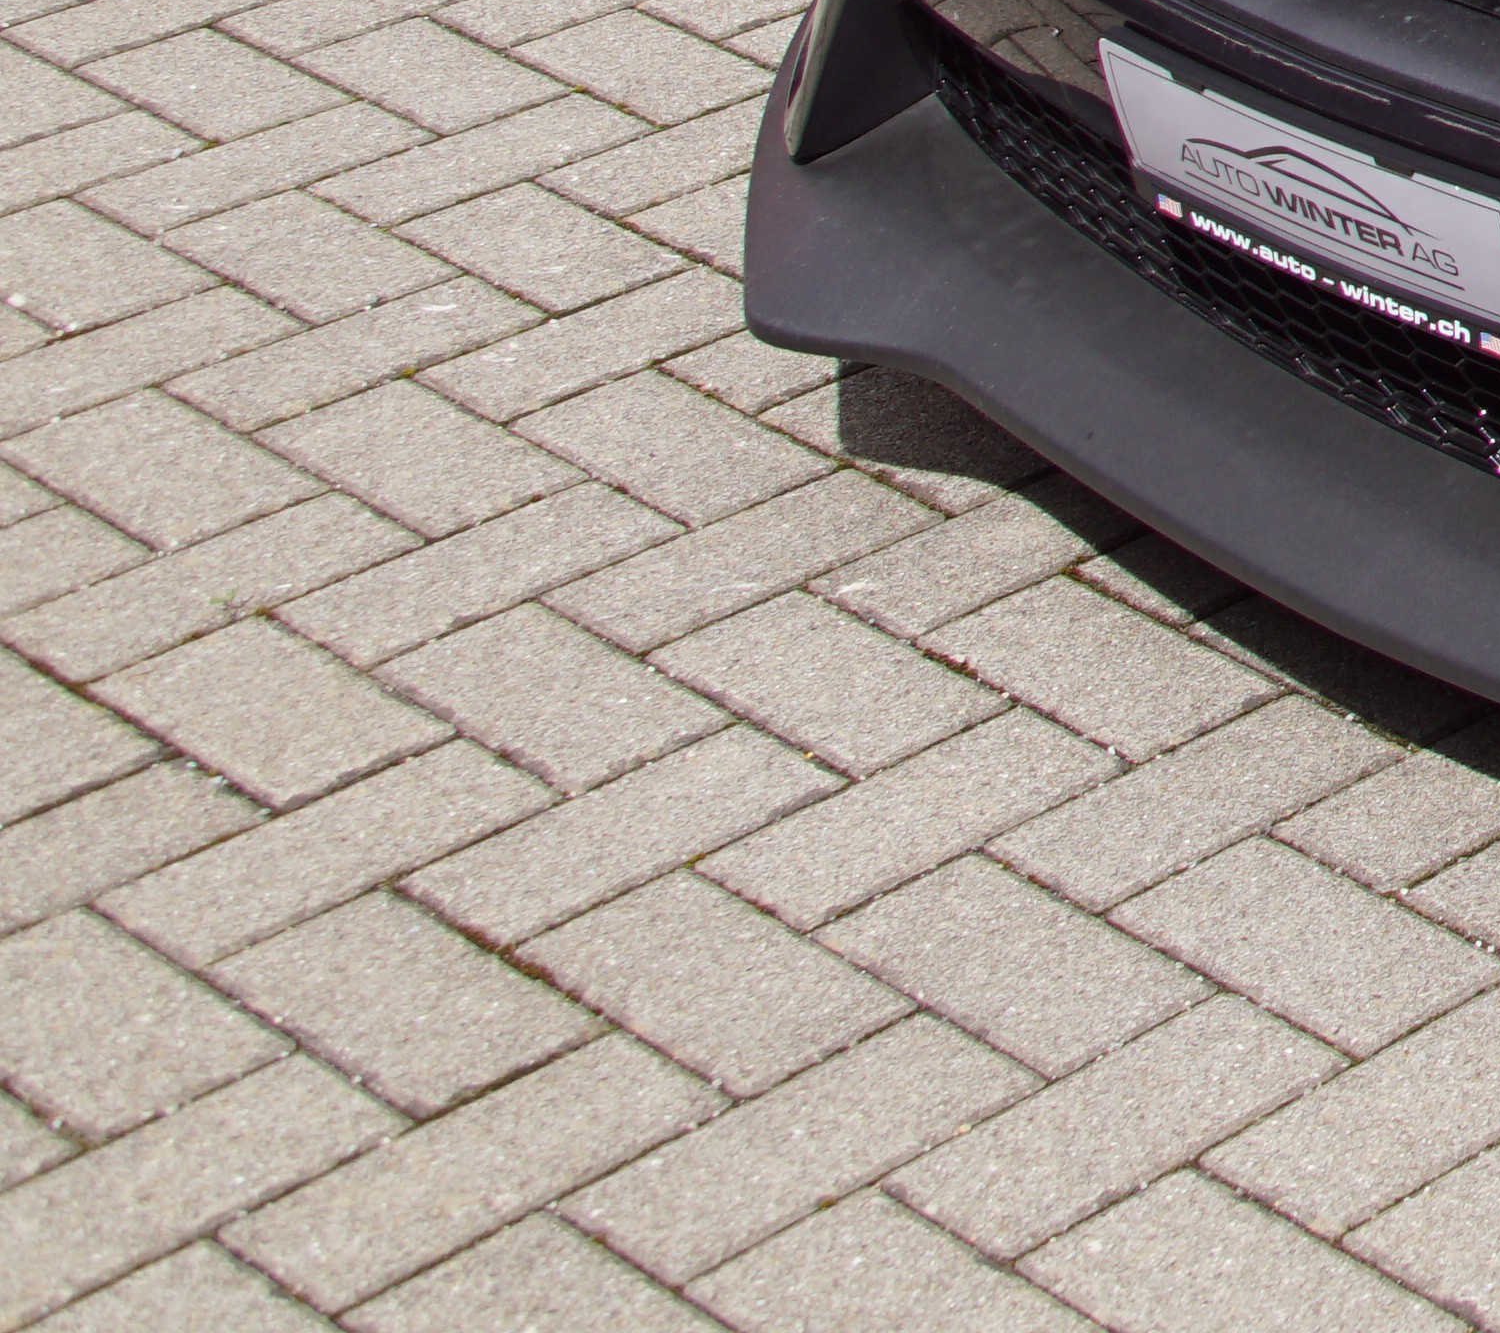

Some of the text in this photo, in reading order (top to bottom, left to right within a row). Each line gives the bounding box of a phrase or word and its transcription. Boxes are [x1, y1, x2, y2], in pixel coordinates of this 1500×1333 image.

[1180, 142, 1460, 277] AUTO WINTER AG
